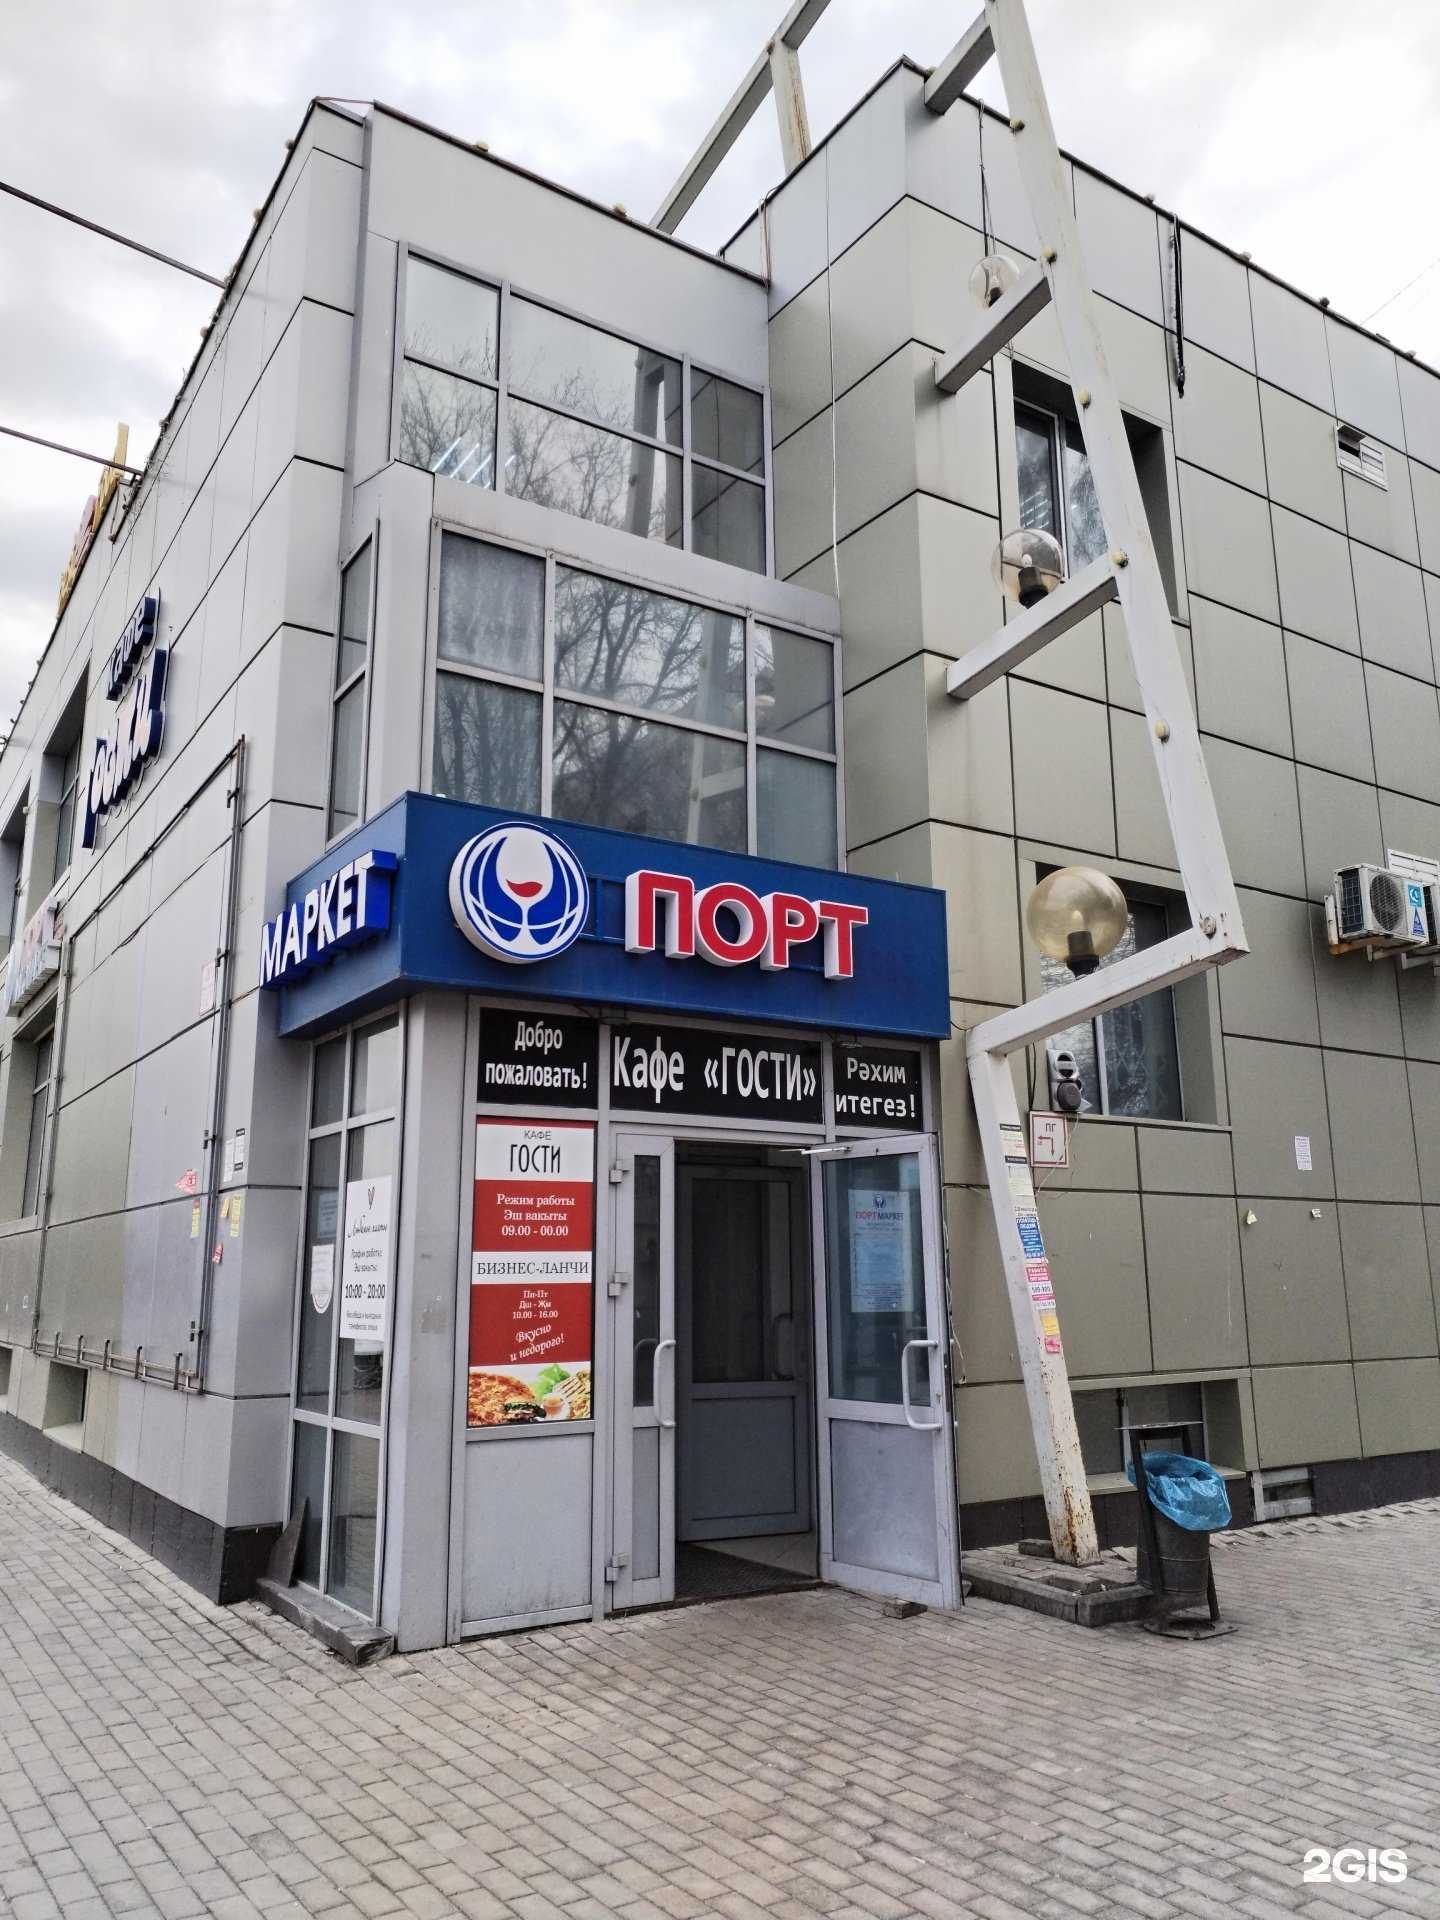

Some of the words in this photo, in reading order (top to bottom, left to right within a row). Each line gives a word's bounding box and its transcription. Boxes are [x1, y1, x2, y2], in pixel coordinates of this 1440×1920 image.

[259, 850, 393, 988] МАРКЕТ
[625, 869, 869, 980] ПОРТ
[514, 1021, 563, 1055] Добро
[485, 1061, 588, 1089] пожаловать!
[613, 1036, 685, 1104] Кафе
[704, 1047, 817, 1101] «ГОСТИ»
[846, 1057, 907, 1084] Рәхим
[835, 1094, 916, 1118] итегез!
[523, 1130, 552, 1140] КАФЕ
[510, 1144, 561, 1174] ГОСТИ
[496, 1194, 534, 1205] Режим
[536, 1195, 577, 1208] работы
[503, 1210, 523, 1220] Эш
[525, 1212, 568, 1221] вакыты
[501, 1225, 531, 1236] 09.00
[540, 1225, 569, 1236] 00.00
[477, 1262, 589, 1275] БИЗНЕС-ЛАНЧИ
[345, 1284, 362, 1299] 10:00
[367, 1284, 386, 1299] 20:00
[523, 1290, 549, 1299] Пн-Пт
[512, 1311, 533, 1320] 10.00
[539, 1310, 559, 1319] 16.00
[515, 1324, 552, 1343] Вкусно
[510, 1353, 517, 1362] и
[519, 1333, 565, 1359] недорого!
